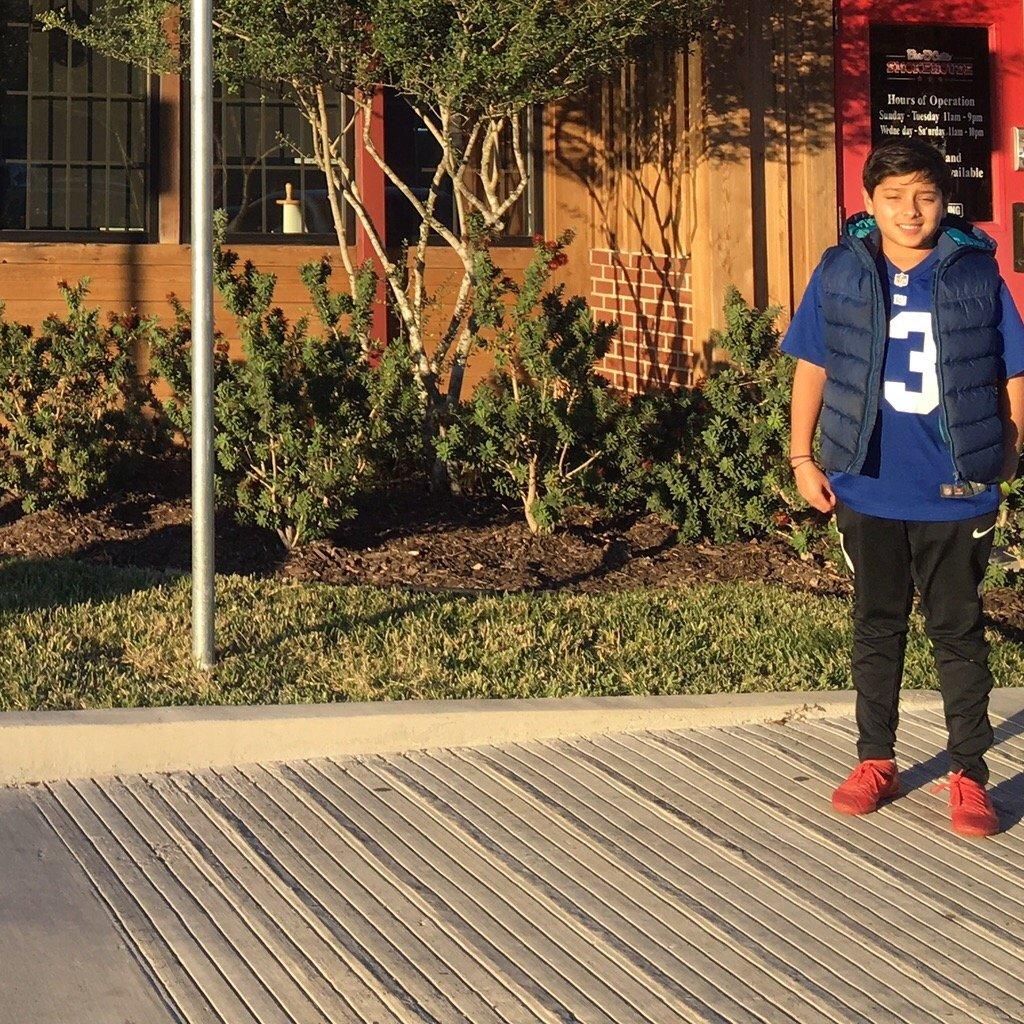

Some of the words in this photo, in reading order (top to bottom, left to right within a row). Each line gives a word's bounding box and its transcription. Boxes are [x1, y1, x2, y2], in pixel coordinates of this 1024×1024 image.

[887, 94, 916, 105] Hours
[917, 95, 927, 106] of
[929, 95, 975, 108] Operation
[879, 110, 905, 123] Sunday
[911, 110, 940, 124] Tuesday
[943, 111, 961, 122] 11am
[967, 112, 983, 124] 9pm
[880, 125, 913, 138] Wedneday
[945, 152, 962, 163] and
[884, 311, 940, 414] 3
